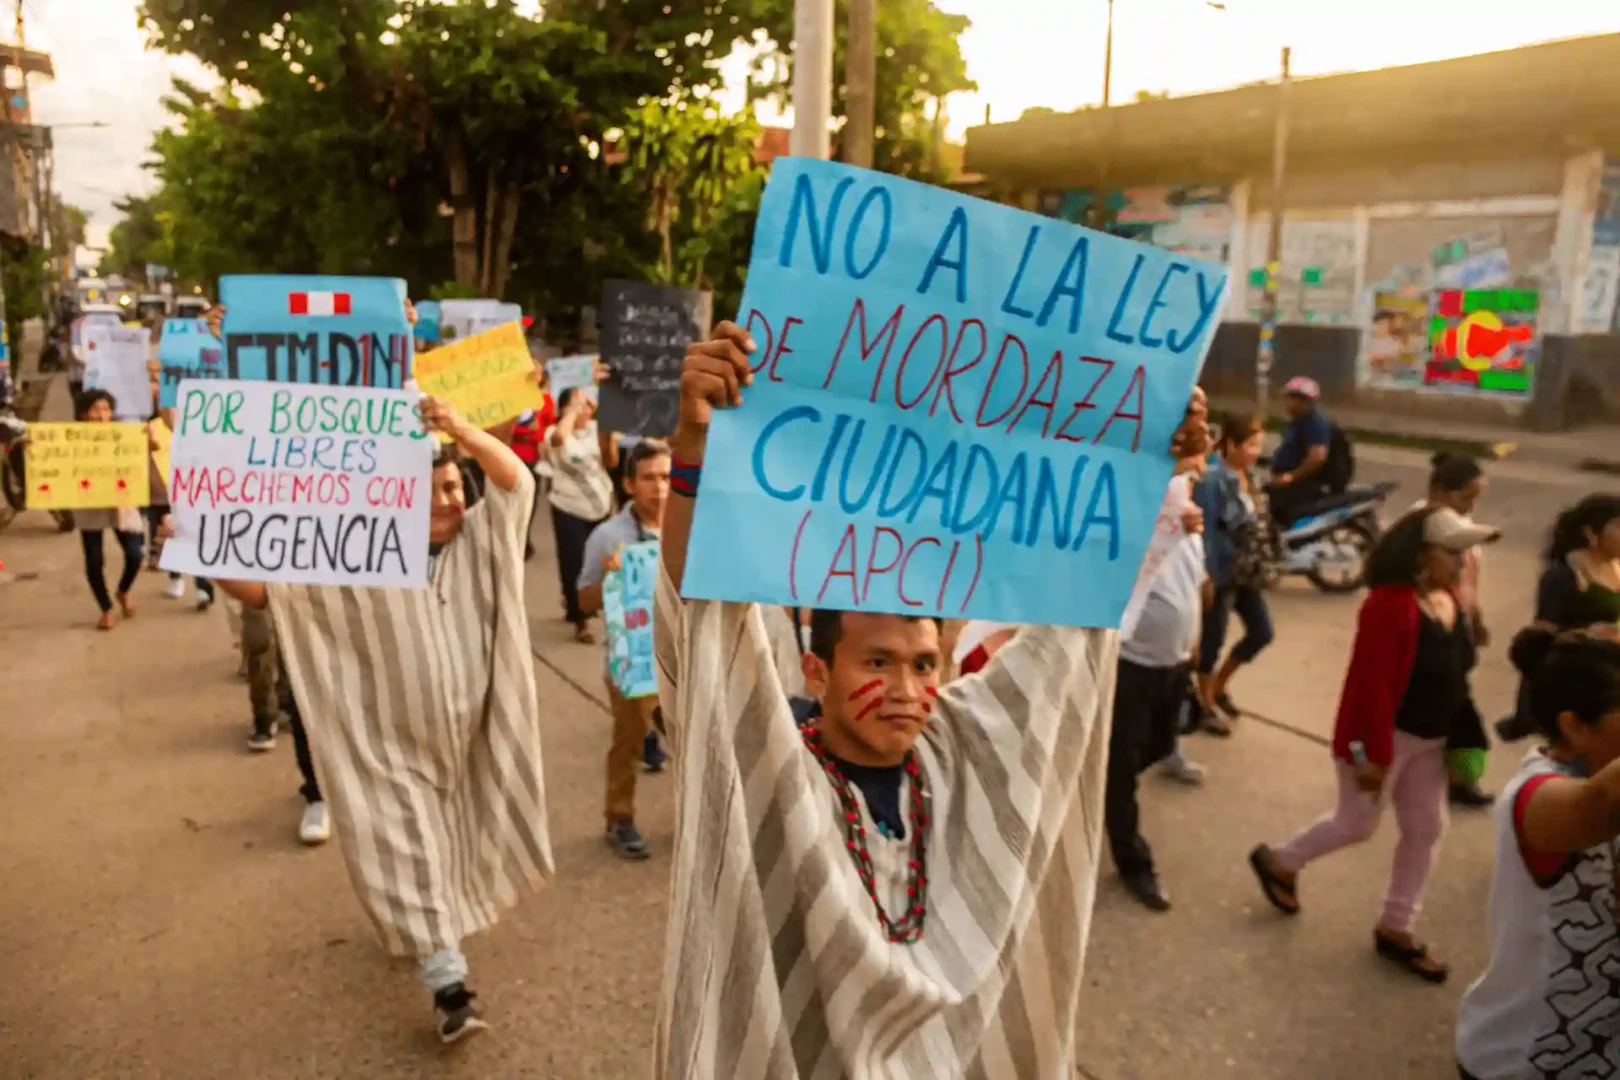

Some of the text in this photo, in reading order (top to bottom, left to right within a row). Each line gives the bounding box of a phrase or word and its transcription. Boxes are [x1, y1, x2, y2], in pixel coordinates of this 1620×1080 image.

[779, 173, 1224, 354] NO A LA LEY
[181, 389, 428, 441] POR BOSQUES
[747, 297, 1146, 453] DE MORDAZA
[171, 464, 416, 509] MARCHEMOS CON
[247, 436, 377, 474] LIBRES
[752, 406, 1121, 560] CIUDADANA
[198, 509, 408, 576] URGENCIA
[789, 508, 985, 613] (APCI)
